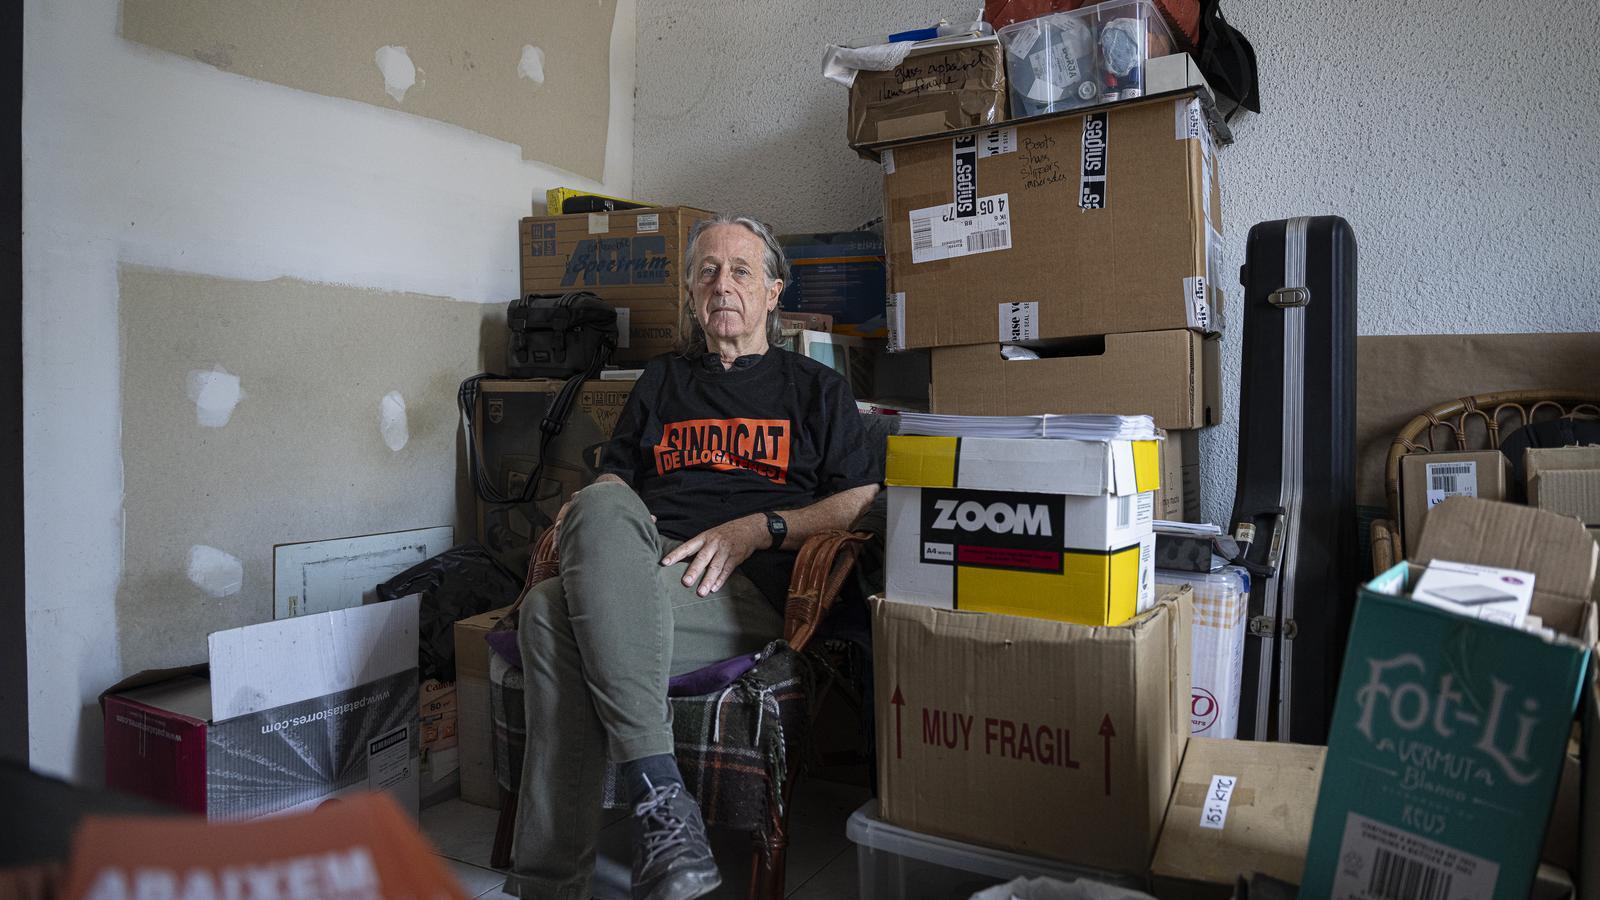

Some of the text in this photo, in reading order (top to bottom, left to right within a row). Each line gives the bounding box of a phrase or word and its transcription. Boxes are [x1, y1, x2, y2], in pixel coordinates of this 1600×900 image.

[1084, 115, 1103, 171] snipes
[957, 162, 975, 212] snipes
[631, 327, 673, 339] MONITOR
[663, 452, 681, 471] DE
[668, 424, 784, 460] SINDICAT
[931, 499, 1053, 537] ZOOM
[425, 680, 457, 693] Canon
[261, 690, 391, 735] www.patatastorres.com
[1356, 652, 1540, 785] Fot-Li
[922, 707, 1080, 770] MUY FRAGIL
[1399, 739, 1475, 782] VERMUT
